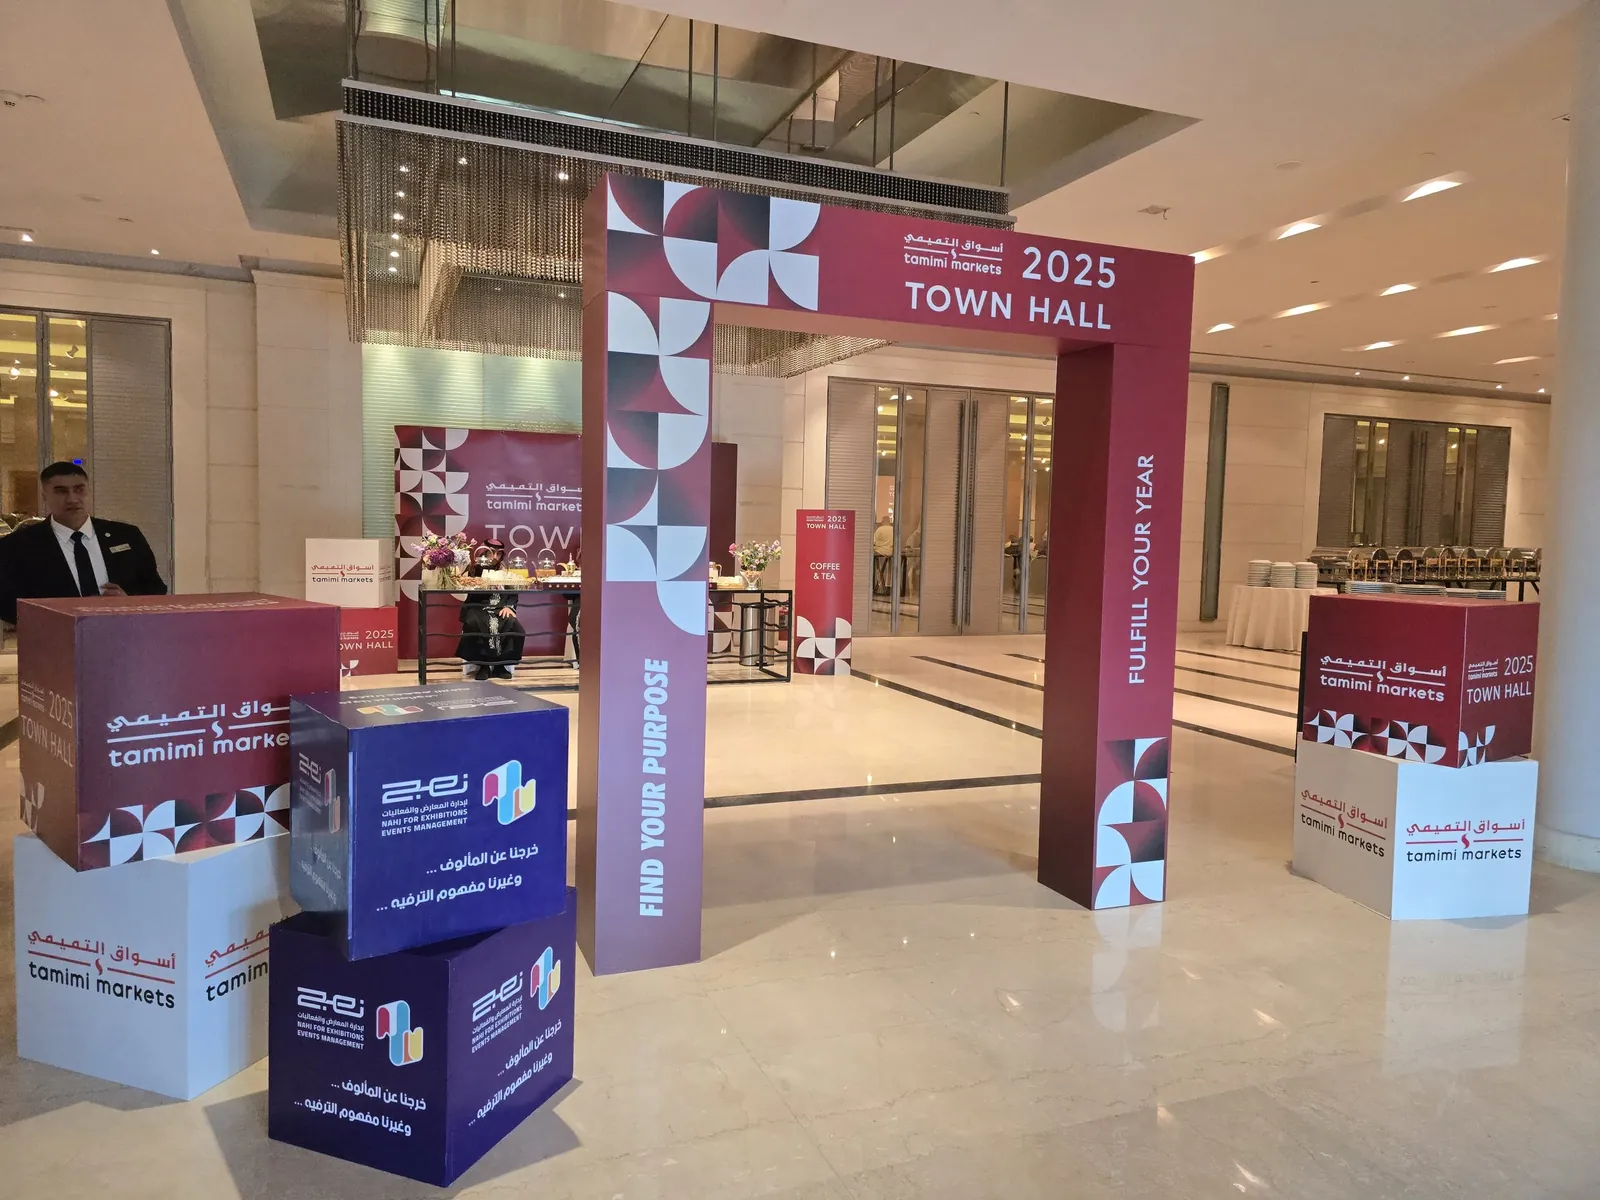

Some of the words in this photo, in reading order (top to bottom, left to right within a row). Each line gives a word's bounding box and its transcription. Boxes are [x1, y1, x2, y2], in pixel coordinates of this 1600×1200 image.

[904, 233, 959, 247] التميمي
[961, 240, 1003, 253] أسواق
[904, 253, 947, 268] tamimi
[951, 260, 1002, 275] markets
[1022, 246, 1116, 288] 2025
[905, 281, 1012, 320] TOWN
[1029, 296, 1111, 330] HALL
[485, 482, 542, 491] التميمي
[546, 484, 582, 493] واق
[1135, 454, 1154, 514] YEAR
[486, 499, 532, 510] tamimi
[536, 502, 582, 512] market
[827, 515, 847, 523] 2025
[485, 524, 582, 550] TOW
[810, 562, 840, 570] COFFEE
[1132, 521, 1152, 591] YOUR
[813, 572, 819, 580] &
[821, 572, 836, 580] TEA
[365, 629, 394, 640] 2025
[1128, 597, 1148, 684] FULFILL
[340, 642, 363, 650] OWN
[366, 641, 394, 649] HALL
[1320, 655, 1386, 669] التميمي
[1390, 662, 1447, 677] أسواق
[1504, 655, 1534, 676] 2025
[1320, 674, 1372, 692] tamimi
[1376, 683, 1445, 702] markets
[1467, 685, 1500, 704] TOWN
[1504, 681, 1532, 699] HALL
[48, 690, 73, 729] 2025
[106, 703, 226, 733] التميمي
[231, 700, 290, 719] واق
[642, 658, 669, 775] PURPOSE
[21, 714, 48, 750] TOWN
[50, 731, 74, 768] HALL
[108, 739, 204, 768] tamimi
[212, 731, 290, 755] marke
[1301, 789, 1346, 812] التميمي
[381, 818, 401, 827] NAHJ
[403, 815, 419, 824] FOR
[420, 808, 468, 821] EXHIBITIONS
[381, 826, 412, 837] EVENTS
[413, 817, 468, 832] MANAGEMENT
[641, 782, 666, 851] YOUR
[1346, 806, 1388, 829] أسواق
[1473, 819, 1525, 834] أسواق
[1301, 813, 1335, 836] tamimi
[1338, 829, 1385, 857] markets
[1406, 820, 1471, 836] التميمي
[490, 851, 507, 865] عن
[509, 843, 539, 859] خرجنا
[1406, 849, 1457, 862] tamimi
[1461, 847, 1522, 859] markets
[440, 852, 488, 872] المألوف
[436, 881, 486, 902] مفهوم
[488, 873, 522, 889] وغيرنا
[640, 859, 664, 917] FIND
[391, 888, 434, 909] الترفيه
[27, 930, 105, 955] التميمي
[205, 930, 269, 968] ميمي
[109, 945, 176, 970] أسواق
[28, 961, 90, 990] tamimi
[96, 978, 175, 1009] markets
[206, 961, 268, 1002] tamim
[485, 1025, 494, 1036] FOR
[495, 1004, 523, 1028] EXHIBITIONS
[545, 1018, 562, 1039] خرجنا
[297, 1021, 312, 1030] NAHJ
[313, 1024, 325, 1032] FOR
[326, 1027, 364, 1041] EXHIBITIONS
[297, 1029, 320, 1040] EVENTS
[321, 1035, 364, 1050] MANAGEMENT
[471, 1036, 490, 1054] EVENTS
[490, 1013, 522, 1040] MANAGEMENT
[534, 1034, 545, 1050] عن
[341, 1079, 382, 1099] المألوف
[503, 1068, 532, 1100] مفهوم
[304, 1098, 338, 1115] الترفيه
[383, 1088, 398, 1104] عن
[400, 1092, 427, 1111] خرجنا
[476, 1089, 503, 1119] الترفيه
[339, 1107, 380, 1127] مفهوم
[381, 1115, 412, 1137] وغيرنا
